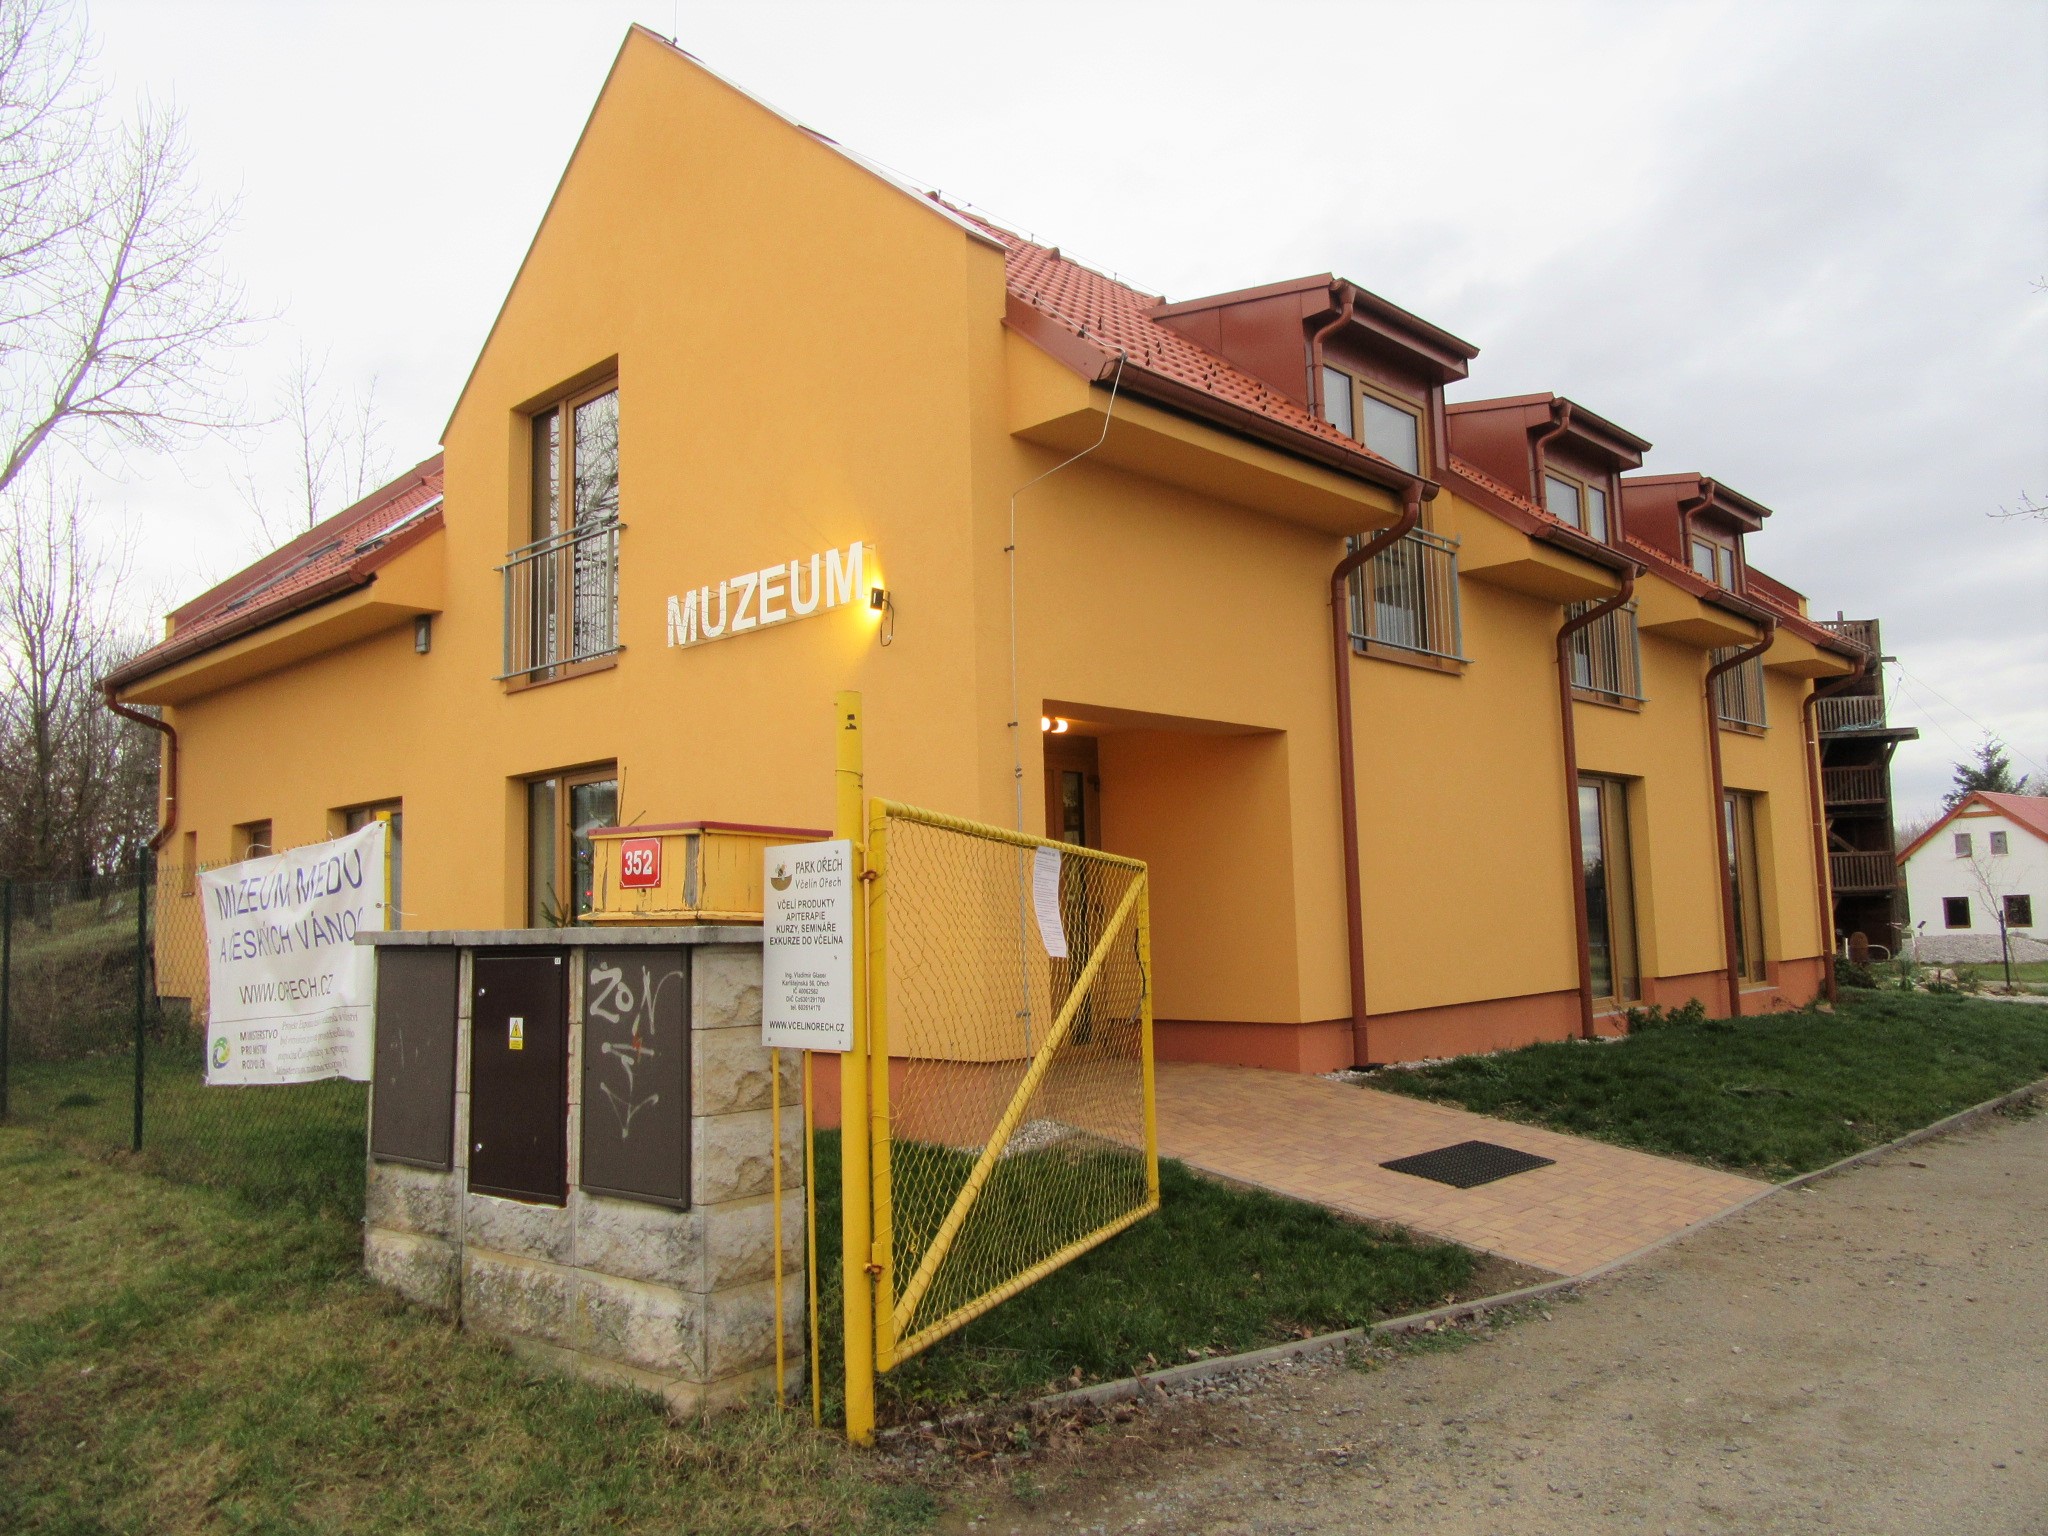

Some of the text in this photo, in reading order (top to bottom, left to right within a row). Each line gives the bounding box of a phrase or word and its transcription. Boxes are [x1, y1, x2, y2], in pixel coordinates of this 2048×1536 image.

[667, 541, 863, 648] MUZEUM
[624, 849, 653, 876] 352
[795, 857, 843, 875] PARK OŘECH
[795, 877, 842, 889] Včelín Ořech
[777, 899, 835, 909] VČELÍ PRODUKTY
[786, 911, 826, 921] APITERAPIE
[776, 921, 836, 934] KURZY, SEMINÁŘE
[769, 934, 844, 946] EXKURZE DO VČELÍNA
[769, 1020, 845, 1032] WWW.VCELINORECH.CZ
